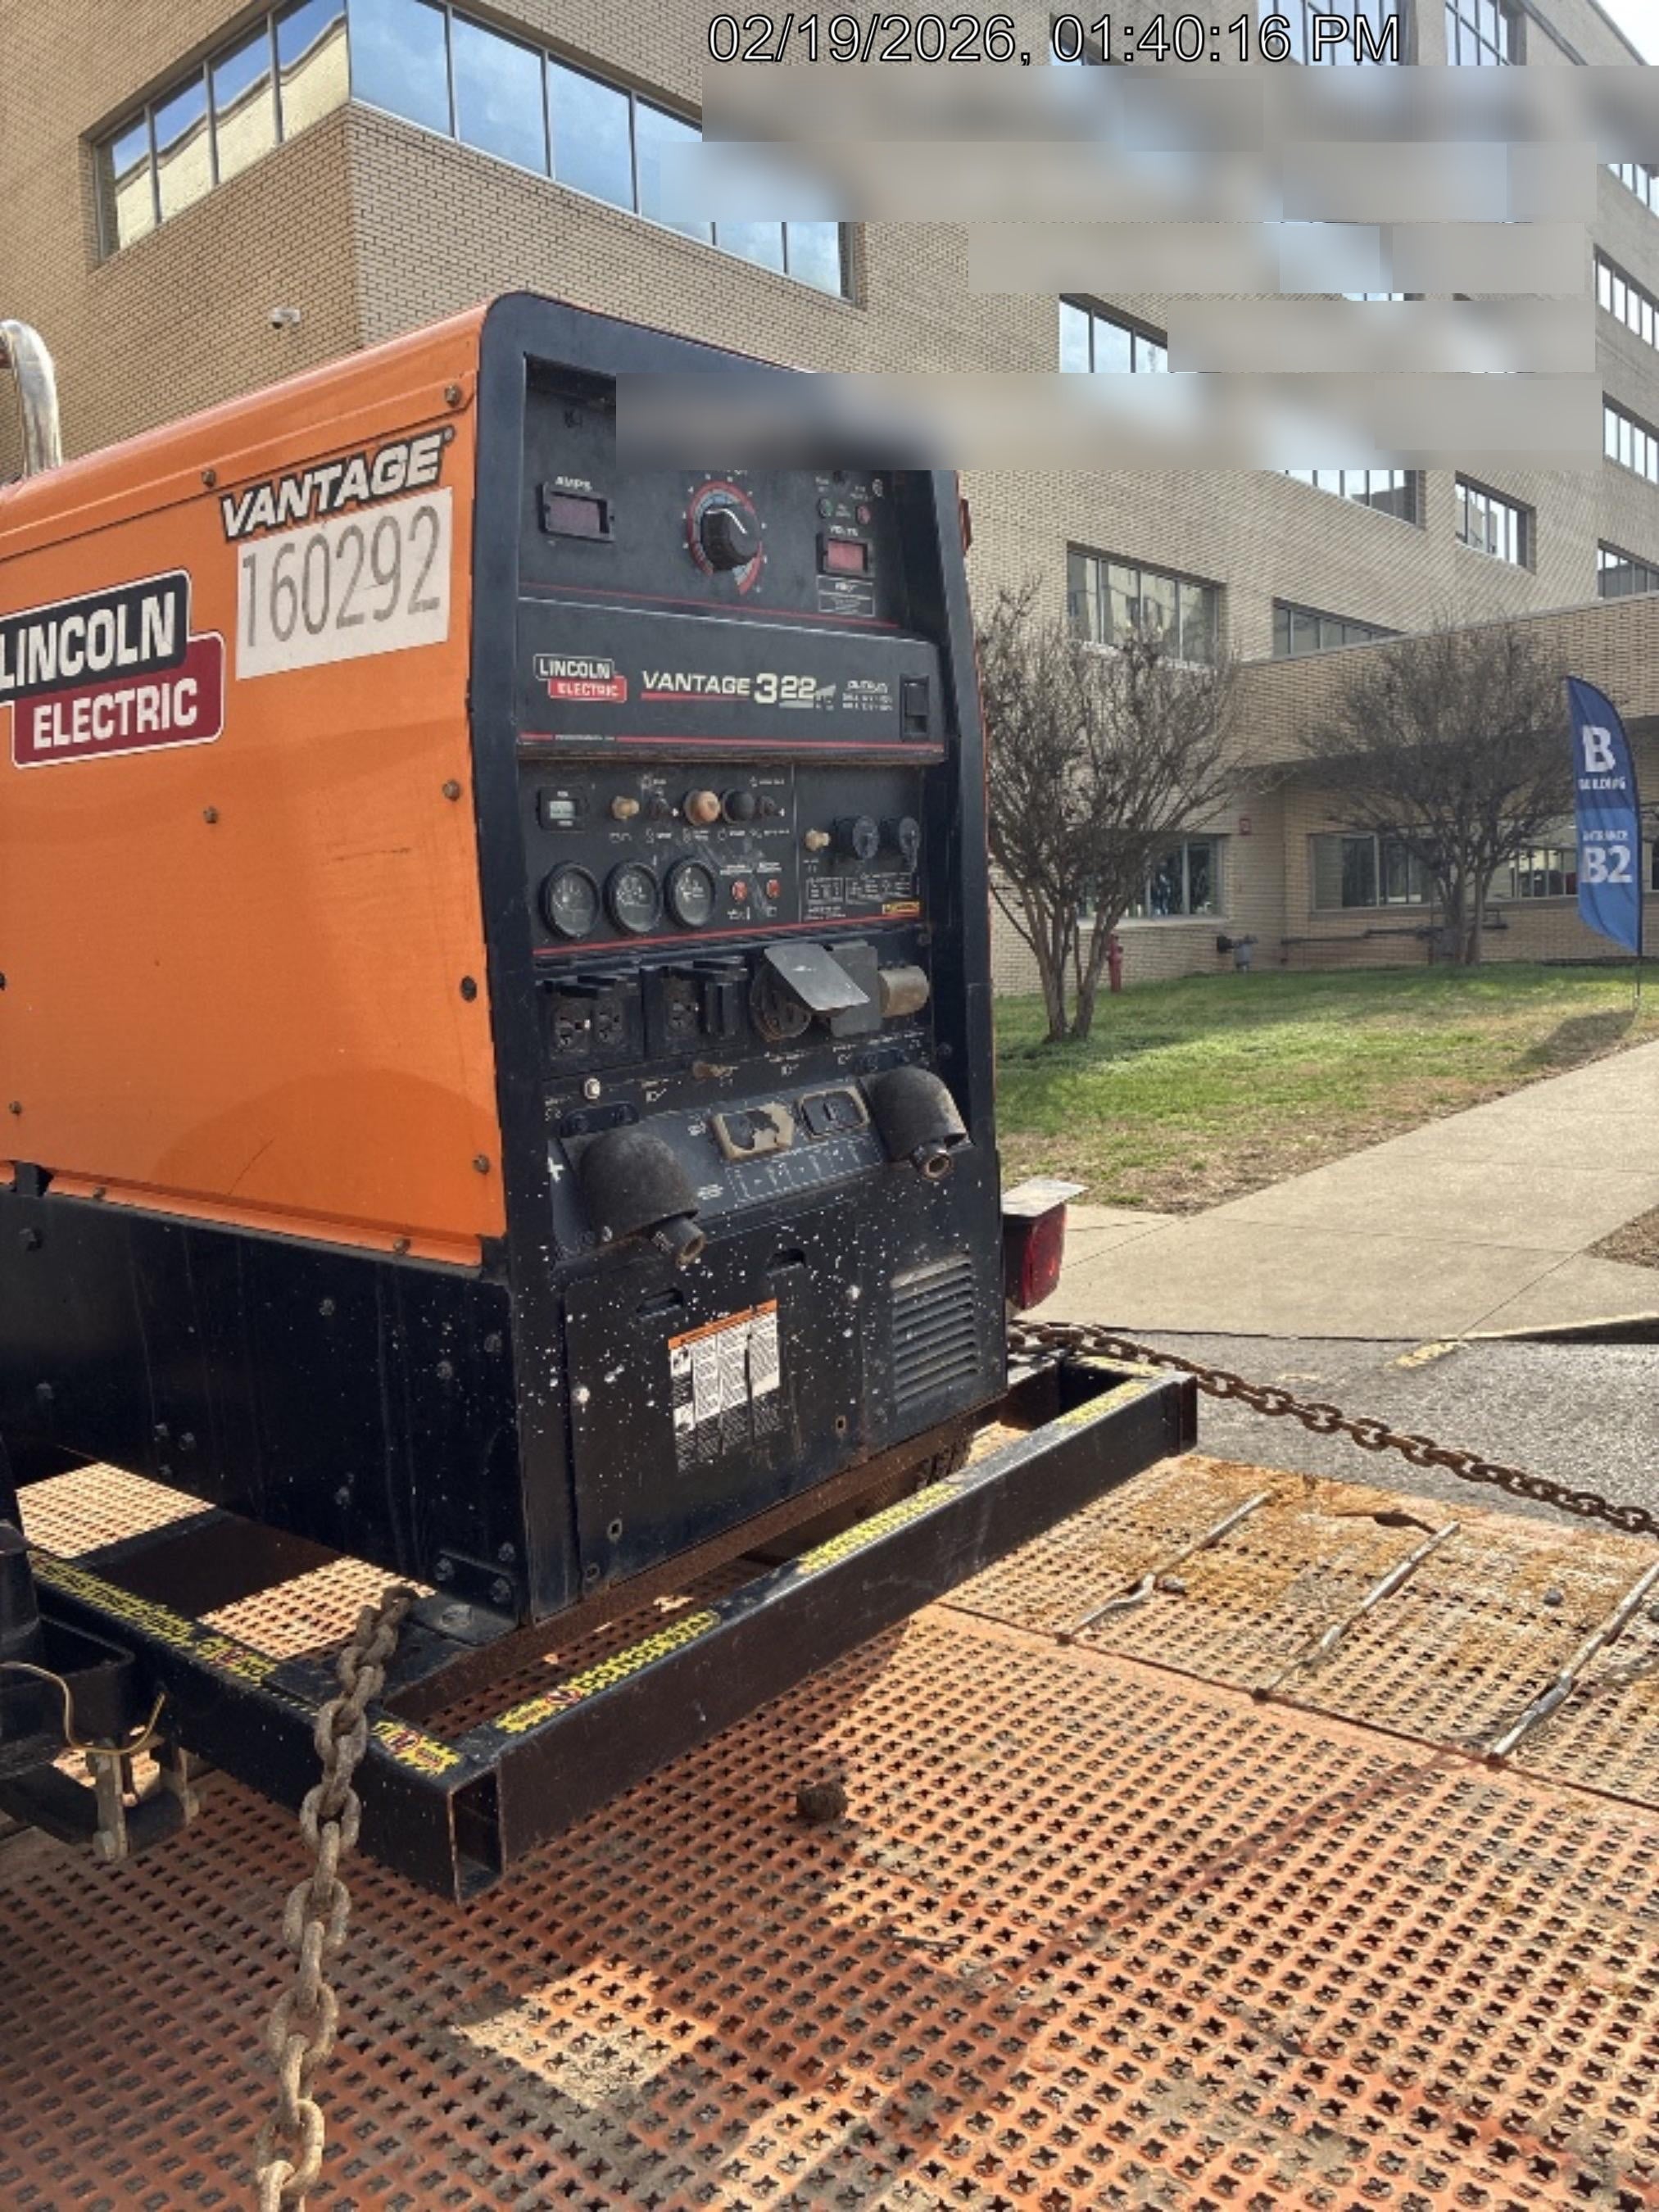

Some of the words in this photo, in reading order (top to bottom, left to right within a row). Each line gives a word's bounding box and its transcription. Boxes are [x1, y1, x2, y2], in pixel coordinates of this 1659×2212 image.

[222, 434, 442, 537] VANTAGE
[243, 505, 441, 647] 160292
[0, 592, 175, 689] LINCOLN
[540, 658, 611, 678] LINCOLN
[557, 682, 619, 697] ELECTRIC
[642, 670, 751, 694] VANTAGE
[754, 673, 817, 704] 322
[33, 678, 197, 750] ELECTRIC
[1582, 725, 1616, 773] B
[1582, 845, 1633, 884] B2
